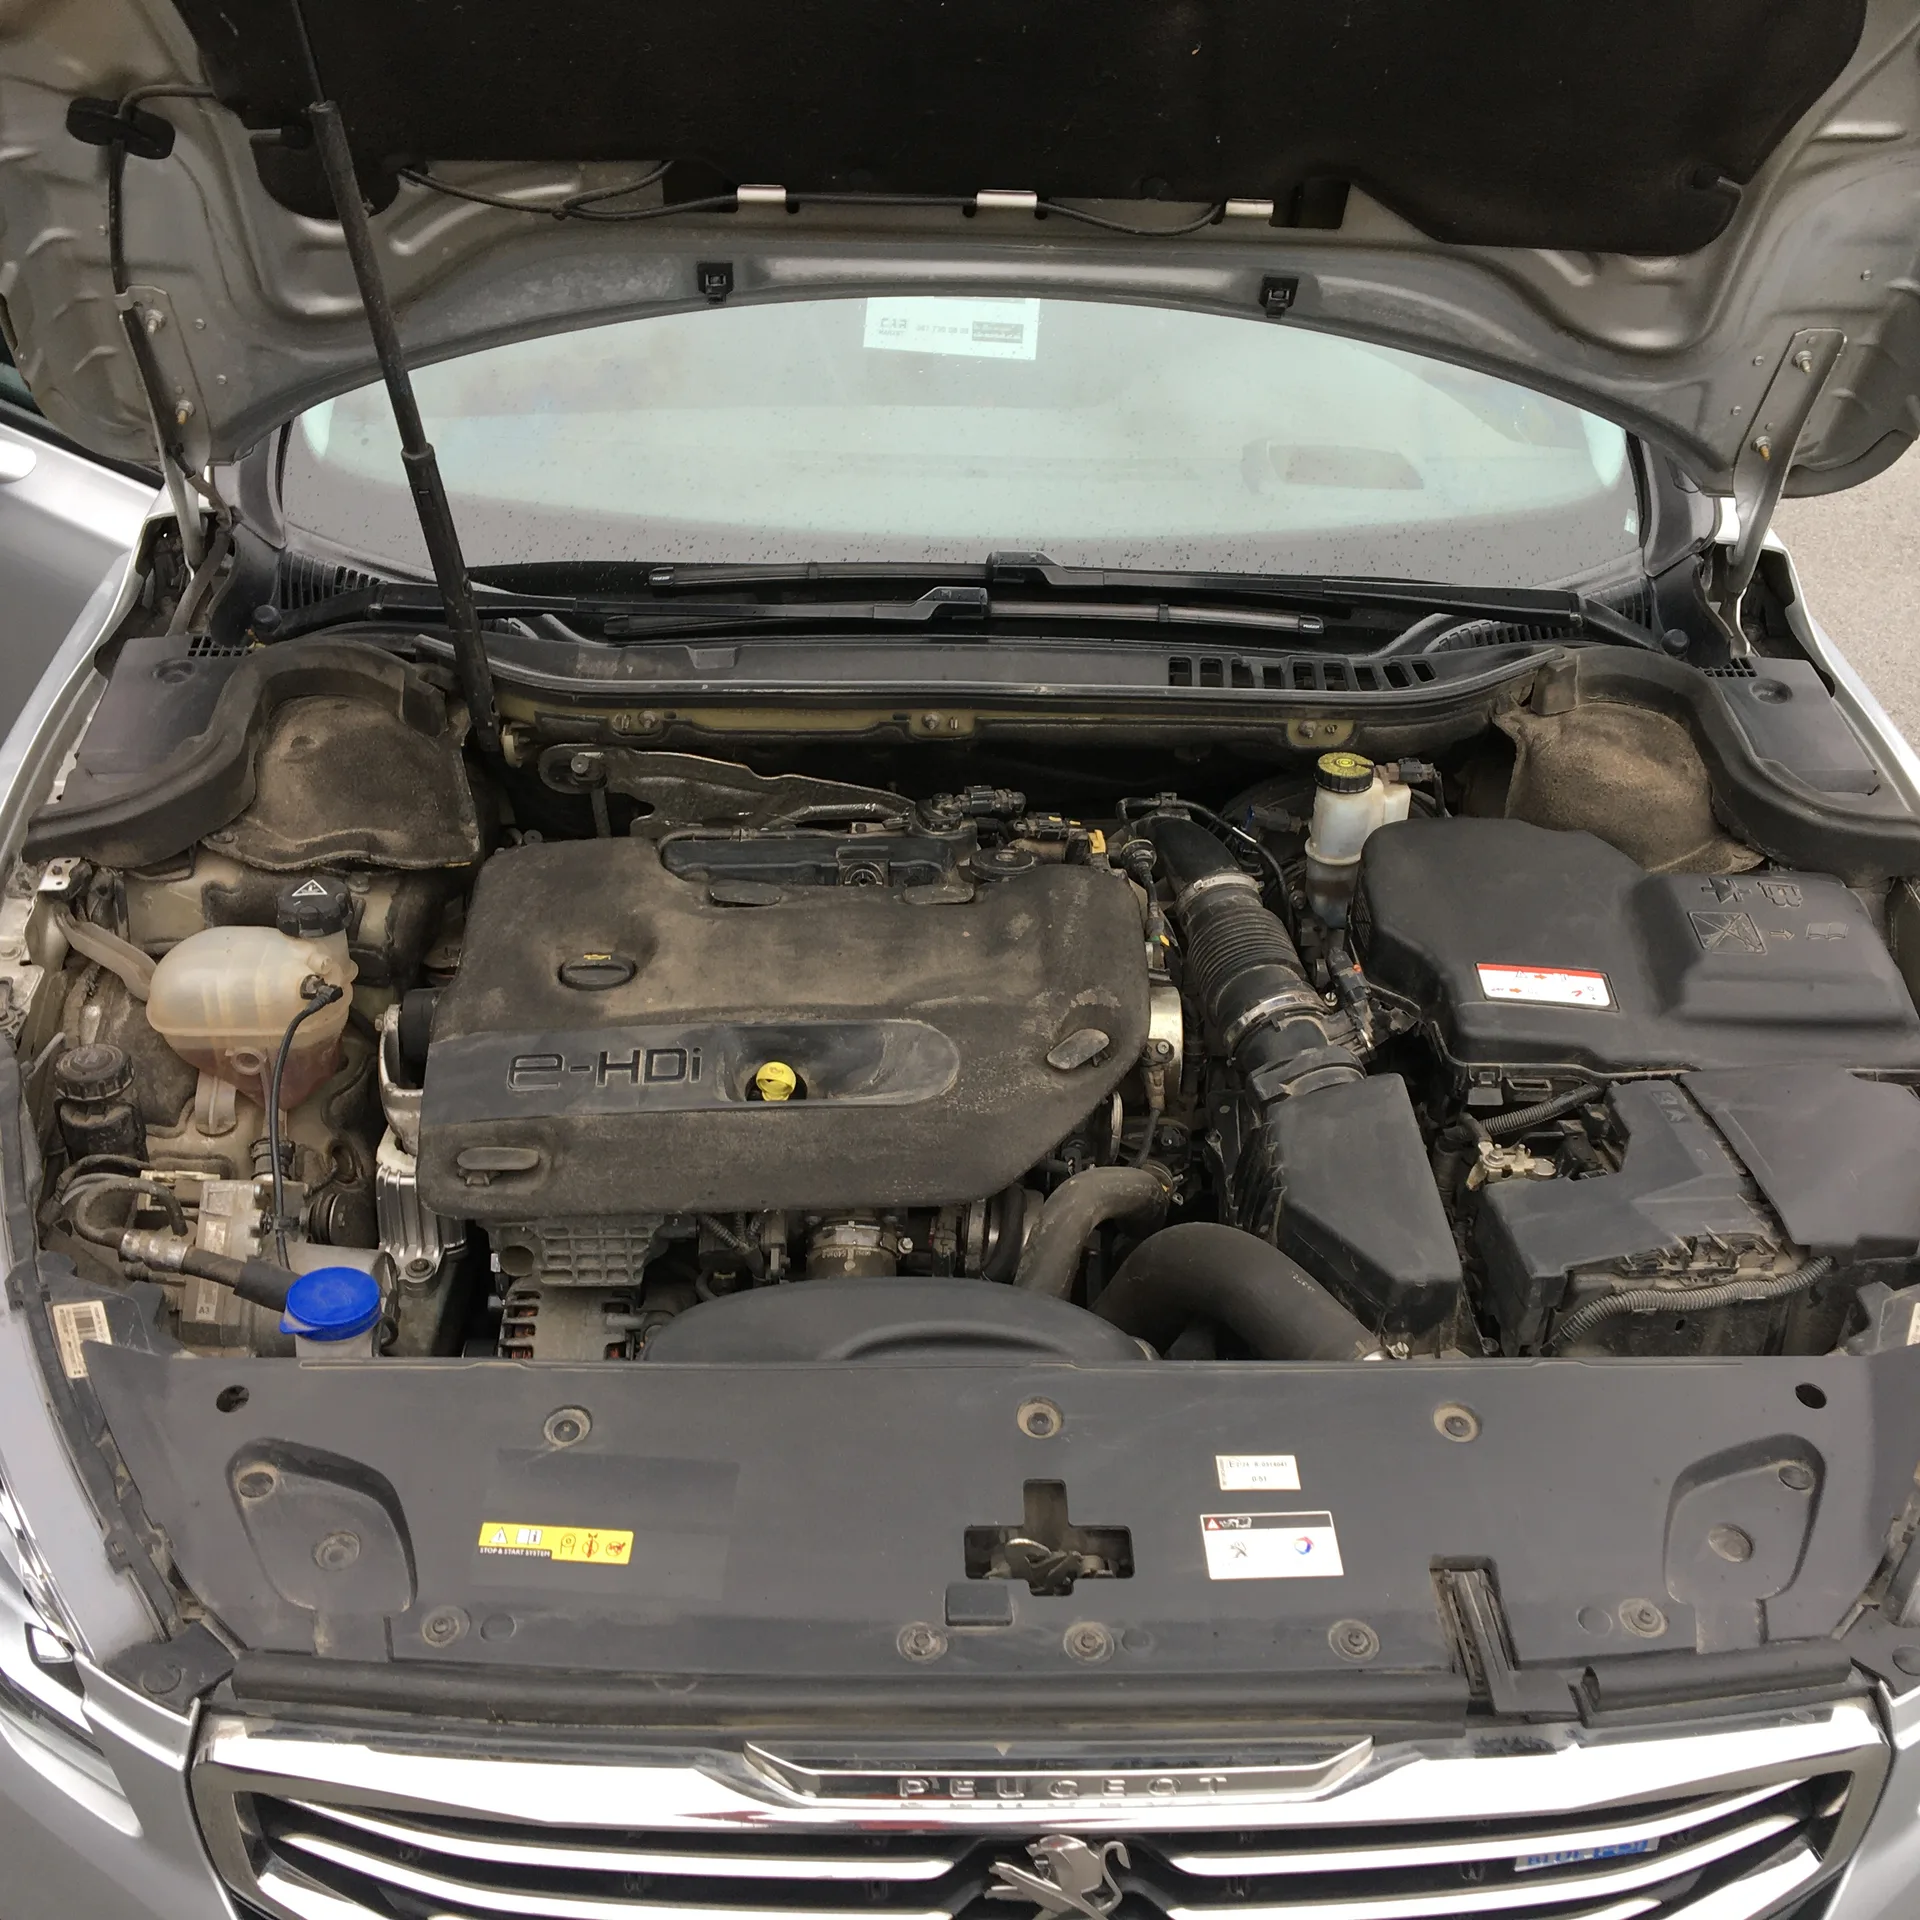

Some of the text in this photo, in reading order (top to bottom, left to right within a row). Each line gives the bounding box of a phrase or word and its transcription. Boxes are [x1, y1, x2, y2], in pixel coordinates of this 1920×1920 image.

[506, 1047, 703, 1092] e-HDi
[504, 1548, 524, 1556] START
[525, 1549, 551, 1557] SYSTEM
[897, 1776, 1227, 1799] PEUGEOT
